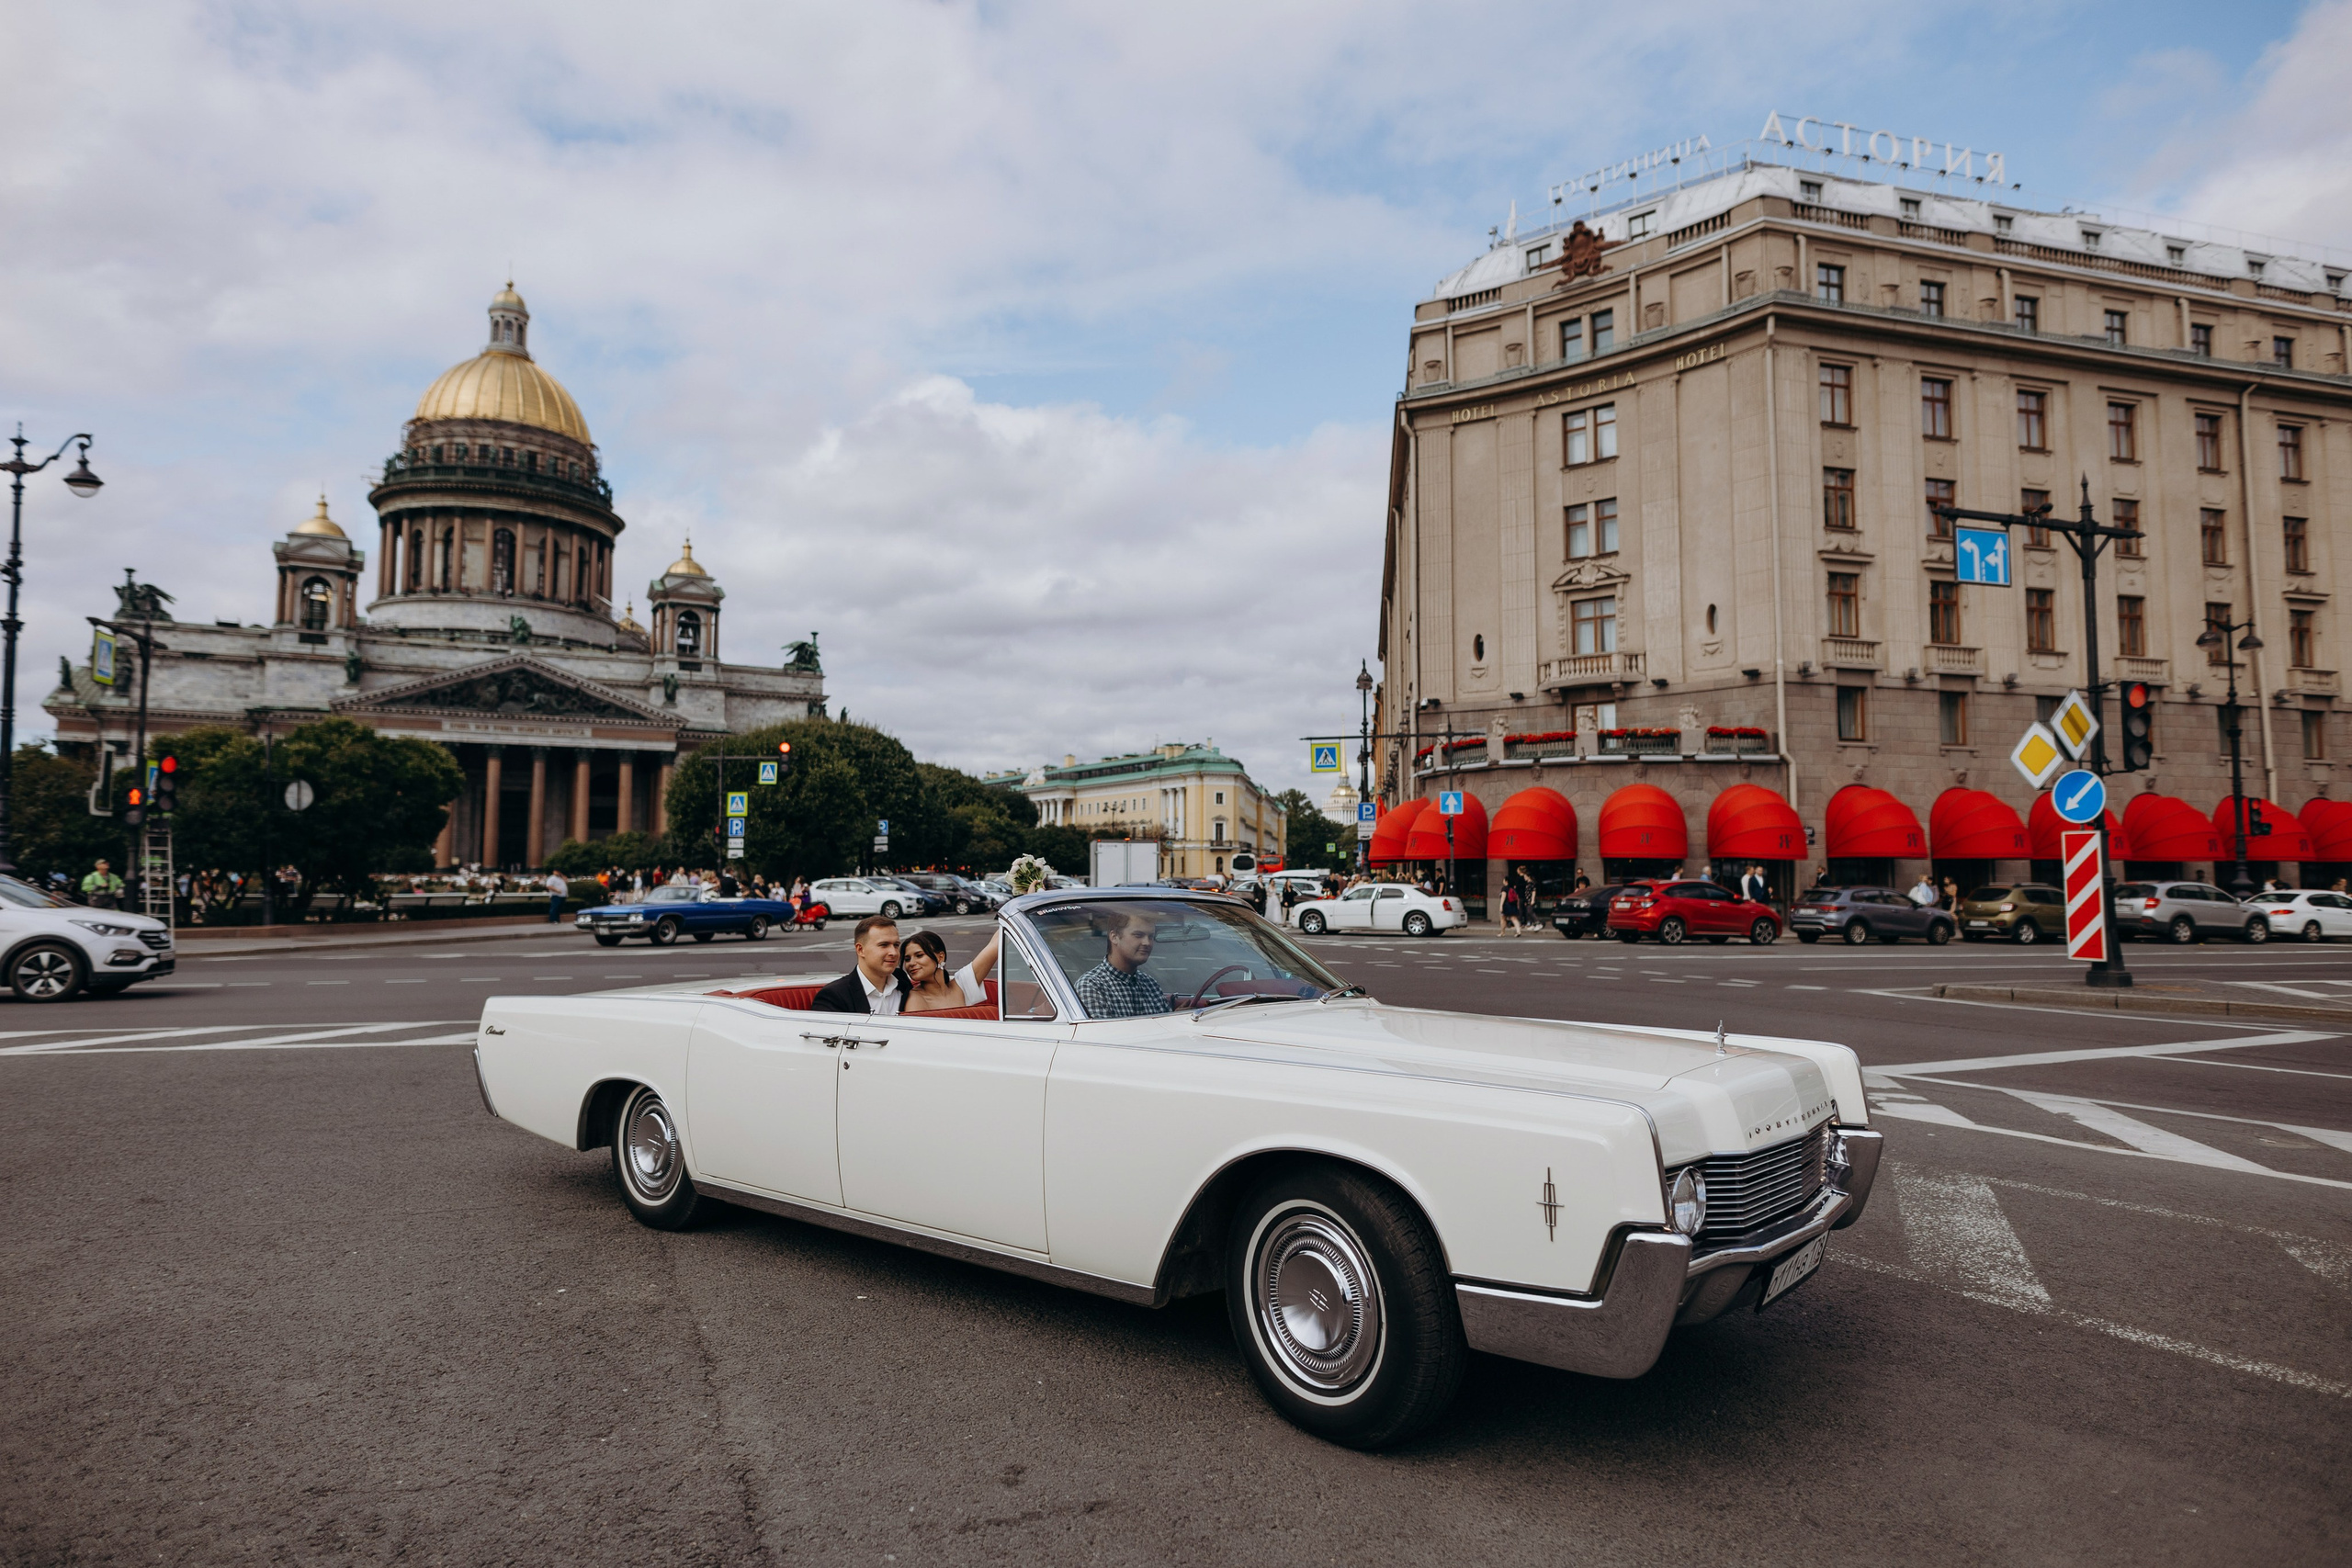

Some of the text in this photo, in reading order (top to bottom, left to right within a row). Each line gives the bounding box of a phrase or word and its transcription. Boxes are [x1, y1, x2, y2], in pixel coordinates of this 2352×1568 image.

[1548, 109, 2004, 203] ГОСТИНИЦА АСТОРИЯ
[1452, 342, 1728, 424] HOTEL ASTORIA HOTEL
